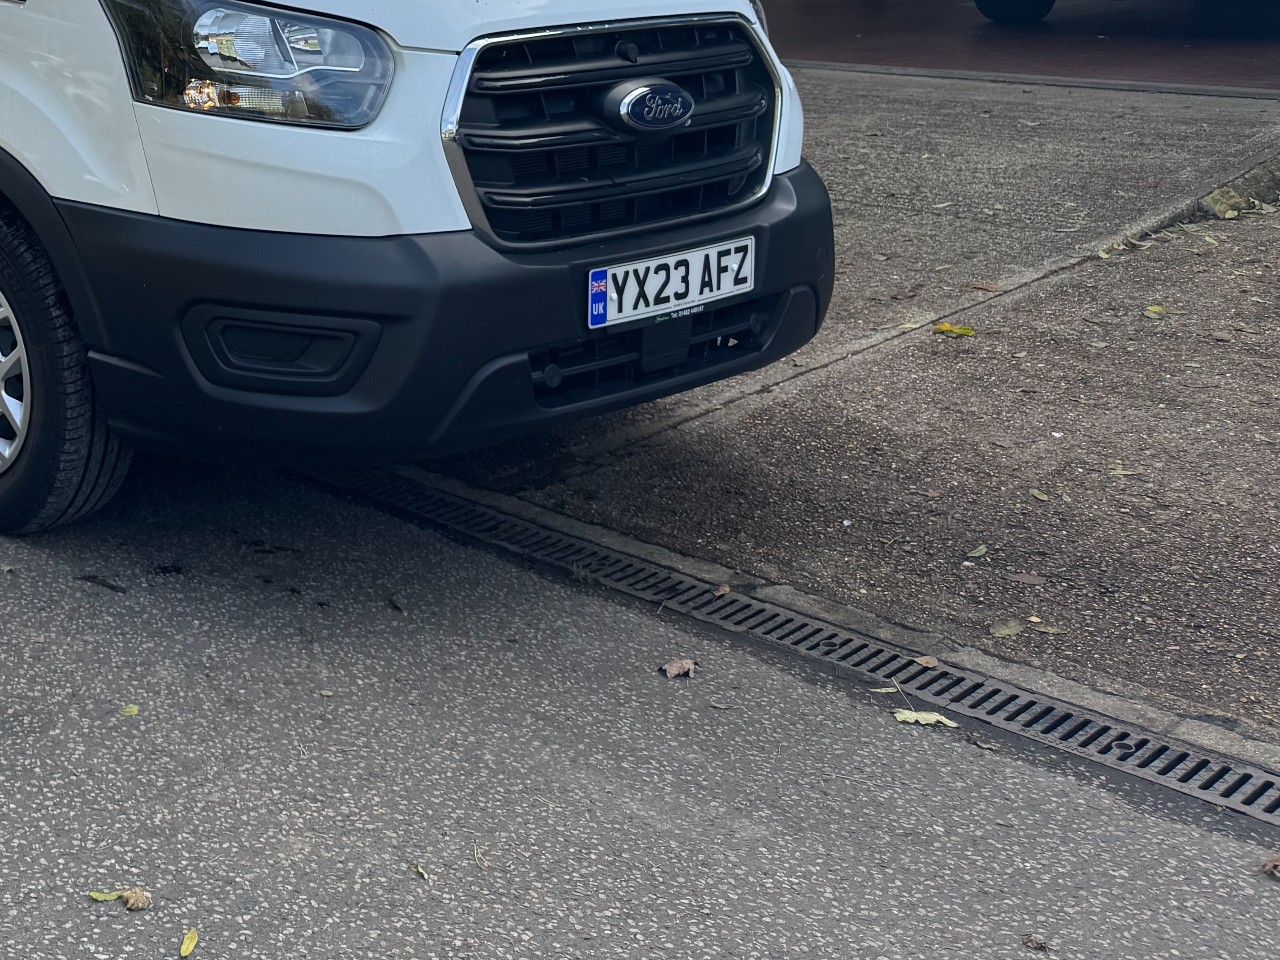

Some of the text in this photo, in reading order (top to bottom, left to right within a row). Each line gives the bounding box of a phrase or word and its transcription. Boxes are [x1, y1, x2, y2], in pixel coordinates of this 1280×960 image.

[644, 94, 682, 120] Ford
[611, 244, 749, 314] YX23 AFZ
[592, 302, 604, 315] UK
